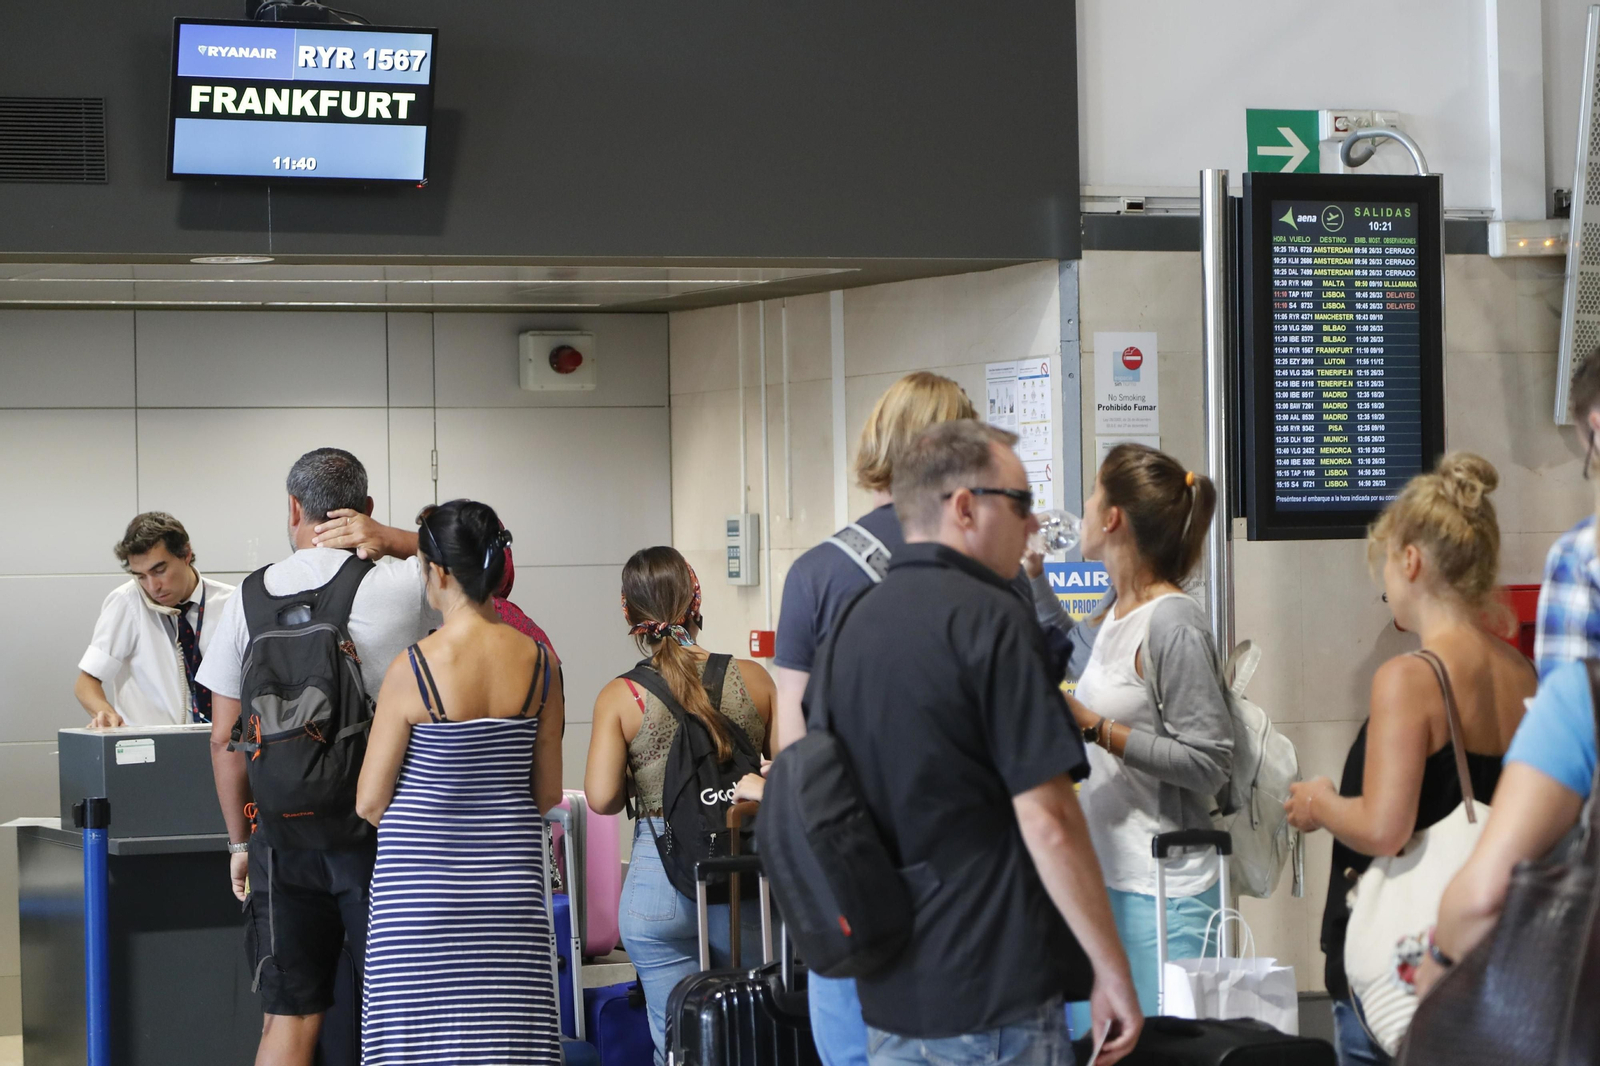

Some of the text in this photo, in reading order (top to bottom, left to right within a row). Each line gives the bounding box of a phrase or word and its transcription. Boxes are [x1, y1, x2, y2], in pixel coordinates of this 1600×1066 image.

[208, 46, 277, 59] RYANAIR
[297, 45, 427, 72] RYR 1567
[190, 85, 416, 120] FRANKFURT
[272, 156, 318, 172] 11:40
[1354, 207, 1411, 218] SALIDAS
[1297, 214, 1317, 223] aena
[1368, 221, 1392, 231] 10:21
[1118, 393, 1146, 403] Smoking
[1097, 403, 1132, 411] Prohibido
[1307, 495, 1330, 503] embarque
